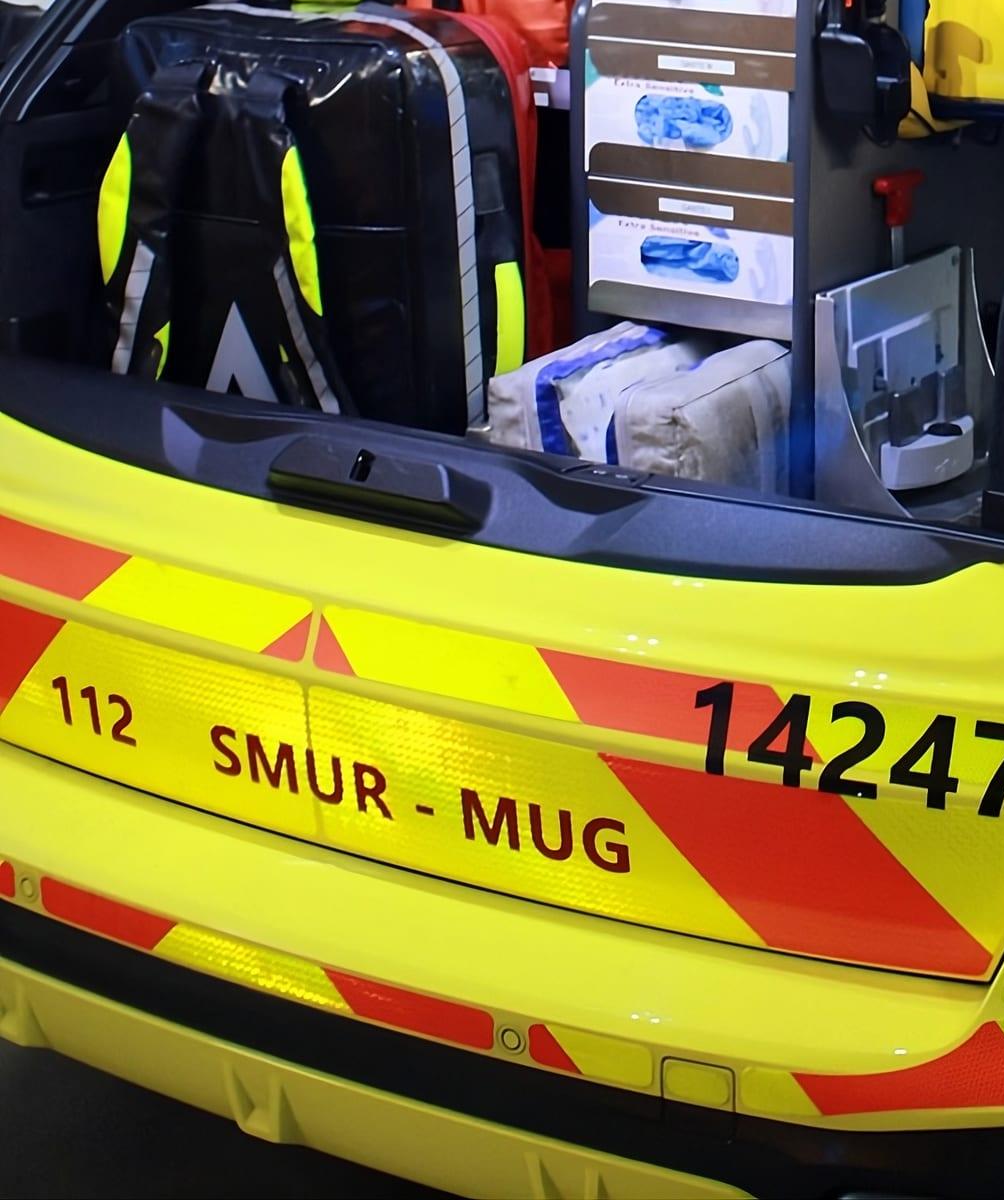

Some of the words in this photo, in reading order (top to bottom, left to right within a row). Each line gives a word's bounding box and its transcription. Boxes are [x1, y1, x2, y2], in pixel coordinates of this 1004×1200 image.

[614, 78, 641, 89] Extra
[645, 82, 695, 94] Sensitive
[618, 219, 646, 230] Extra
[650, 223, 700, 237] Sensitive
[52, 676, 137, 747] 112
[211, 725, 394, 820] SMUR
[415, 803, 435, 816] -
[460, 788, 631, 874] MUG
